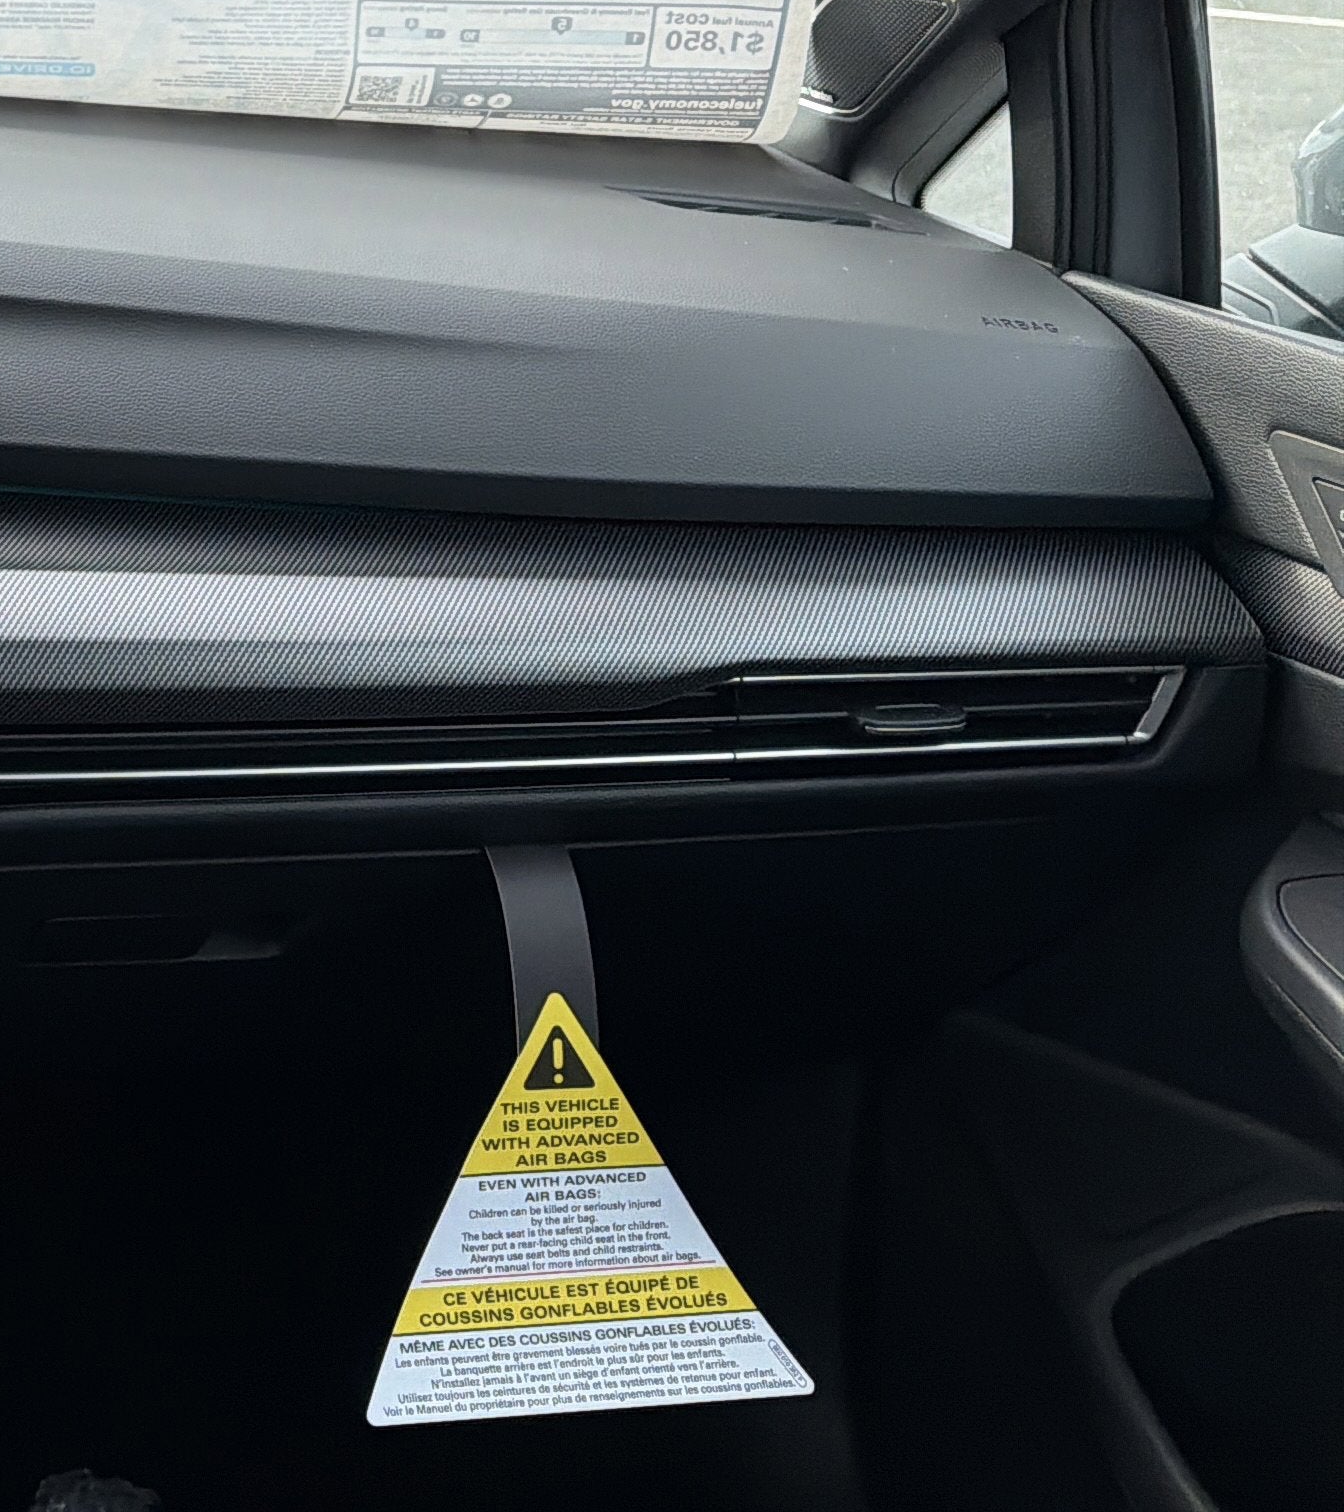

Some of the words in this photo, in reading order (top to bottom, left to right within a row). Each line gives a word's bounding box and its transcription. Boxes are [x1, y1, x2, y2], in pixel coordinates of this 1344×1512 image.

[980, 315, 1059, 335] AIRBAG
[499, 1100, 540, 1116] THIS
[544, 1097, 619, 1113] VEHICLE
[502, 1119, 519, 1133] IS
[525, 1115, 618, 1132] EQUIPPED
[481, 1136, 530, 1151] WITH
[535, 1131, 639, 1148] ADVANCED
[515, 1153, 547, 1167] AIR
[554, 1150, 606, 1165] BAGS
[478, 1179, 516, 1192] EVEN
[520, 1176, 559, 1189] WITH
[563, 1171, 646, 1186] ADVANCED
[524, 1191, 550, 1203] AIR
[554, 1188, 600, 1201] BAGS:
[468, 1208, 508, 1220] Children
[509, 1208, 527, 1217] can
[528, 1205, 541, 1216] be
[542, 1203, 568, 1215] killed
[570, 1204, 581, 1213] or
[582, 1200, 626, 1212] seriously
[627, 1198, 661, 1211] injured
[530, 1216, 543, 1228] by
[544, 1215, 560, 1226] the
[562, 1214, 575, 1225] air
[576, 1213, 598, 1227] bag.
[442, 1291, 467, 1307] CE
[470, 1285, 561, 1304] VÉHICULE
[565, 1282, 599, 1298] EST
[604, 1275, 671, 1295] ÉQUIPÉ
[675, 1275, 700, 1290] DE
[419, 1307, 514, 1327] COUSSINS
[519, 1299, 640, 1320] GONFLABLES
[645, 1291, 727, 1311] ÉVOLUÉS
[399, 1339, 445, 1354] MÊME
[447, 1337, 485, 1351] AVEC
[488, 1335, 516, 1348] DES
[519, 1329, 592, 1346] COUSSINS
[594, 1323, 686, 1340] GONFLABLES
[688, 1317, 755, 1334] ÉVOLUÉS:
